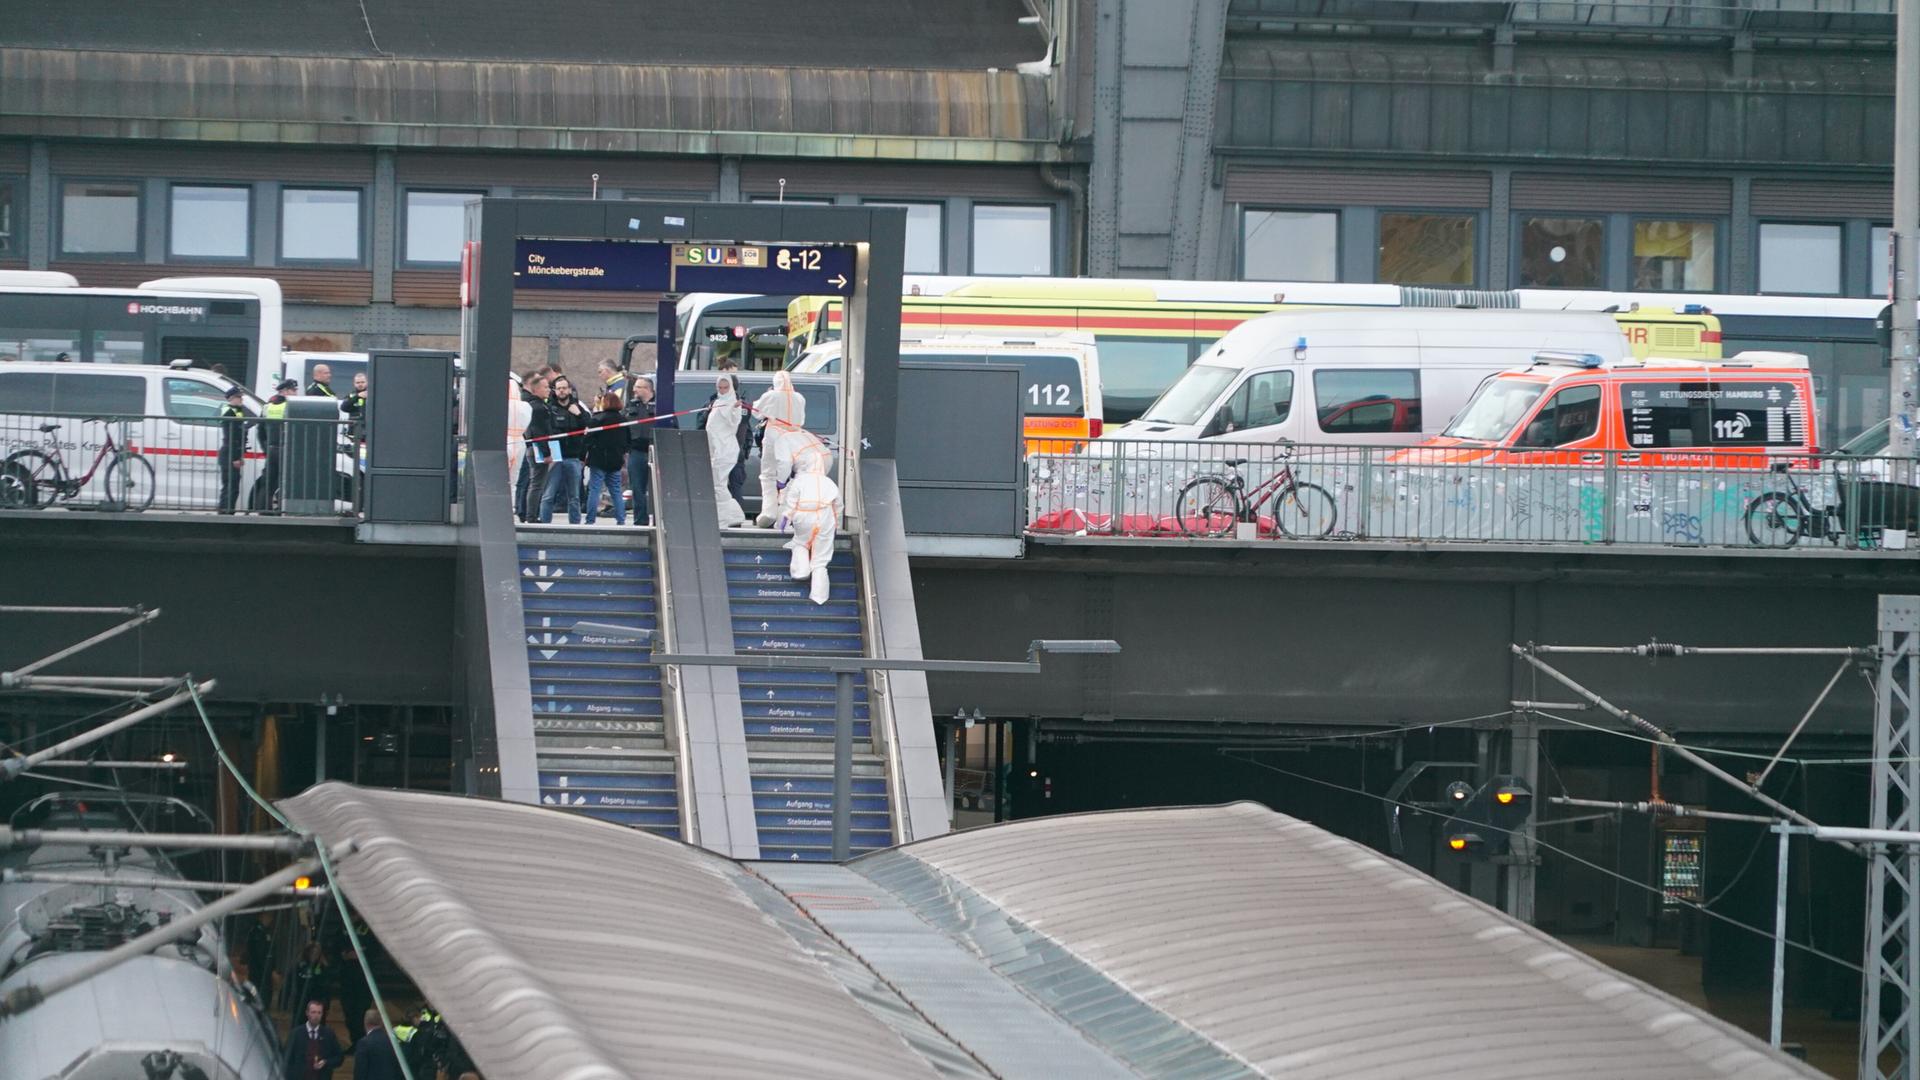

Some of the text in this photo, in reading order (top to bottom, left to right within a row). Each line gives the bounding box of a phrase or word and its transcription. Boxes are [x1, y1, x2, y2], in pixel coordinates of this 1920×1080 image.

[528, 254, 545, 264] City
[688, 248, 702, 263] S
[707, 248, 720, 264] U
[528, 266, 604, 277] Mönckebergstraße
[140, 305, 203, 314] HOCHBAHN
[709, 334, 728, 342] 3422
[1028, 384, 1070, 405] 112
[1659, 391, 1764, 399] RETTUNGSDIENST HAMBURG
[1714, 420, 1745, 439] 112
[577, 568, 601, 577] Abgang
[756, 573, 783, 581] Aufgang
[758, 589, 801, 598] Steintordamm
[582, 635, 606, 644] Abgang
[762, 640, 789, 649] Aufgang
[586, 704, 611, 713] Abgang
[768, 708, 795, 717] Aufgang
[770, 725, 815, 734] Steintordamm
[600, 796, 625, 806] Abgang
[786, 800, 813, 809] Aufgang
